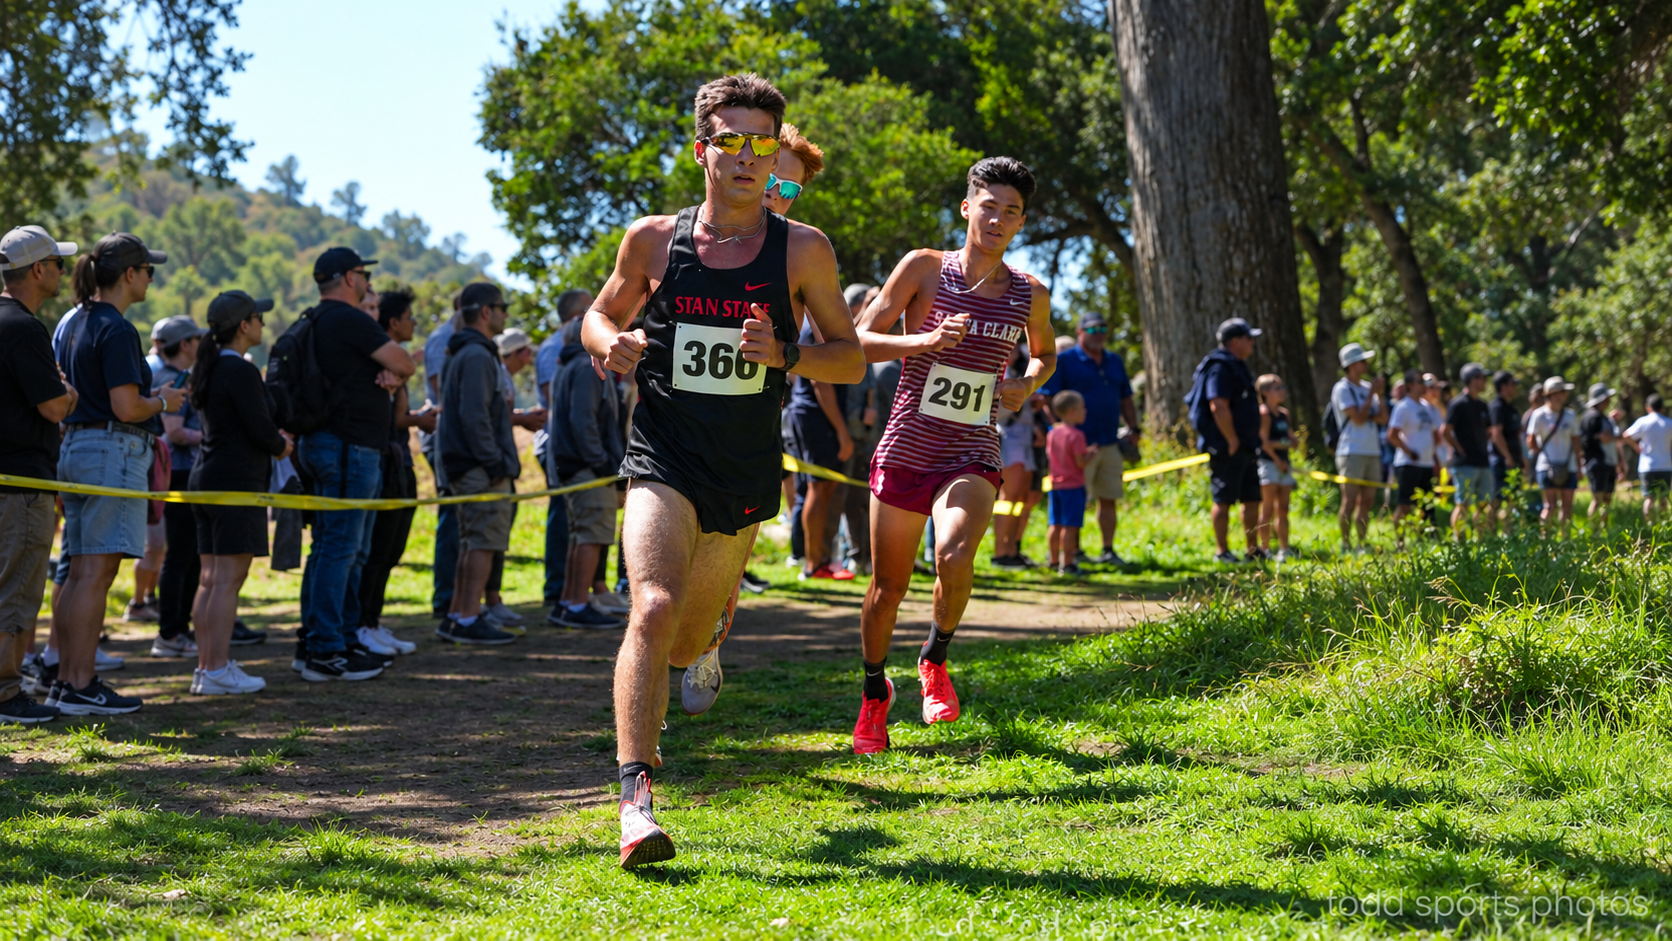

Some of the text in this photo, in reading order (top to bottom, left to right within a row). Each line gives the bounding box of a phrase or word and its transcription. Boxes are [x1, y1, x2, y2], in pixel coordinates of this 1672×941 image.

[675, 296, 771, 318] STAN STAE
[682, 340, 759, 380] 366
[928, 377, 986, 412] 291
